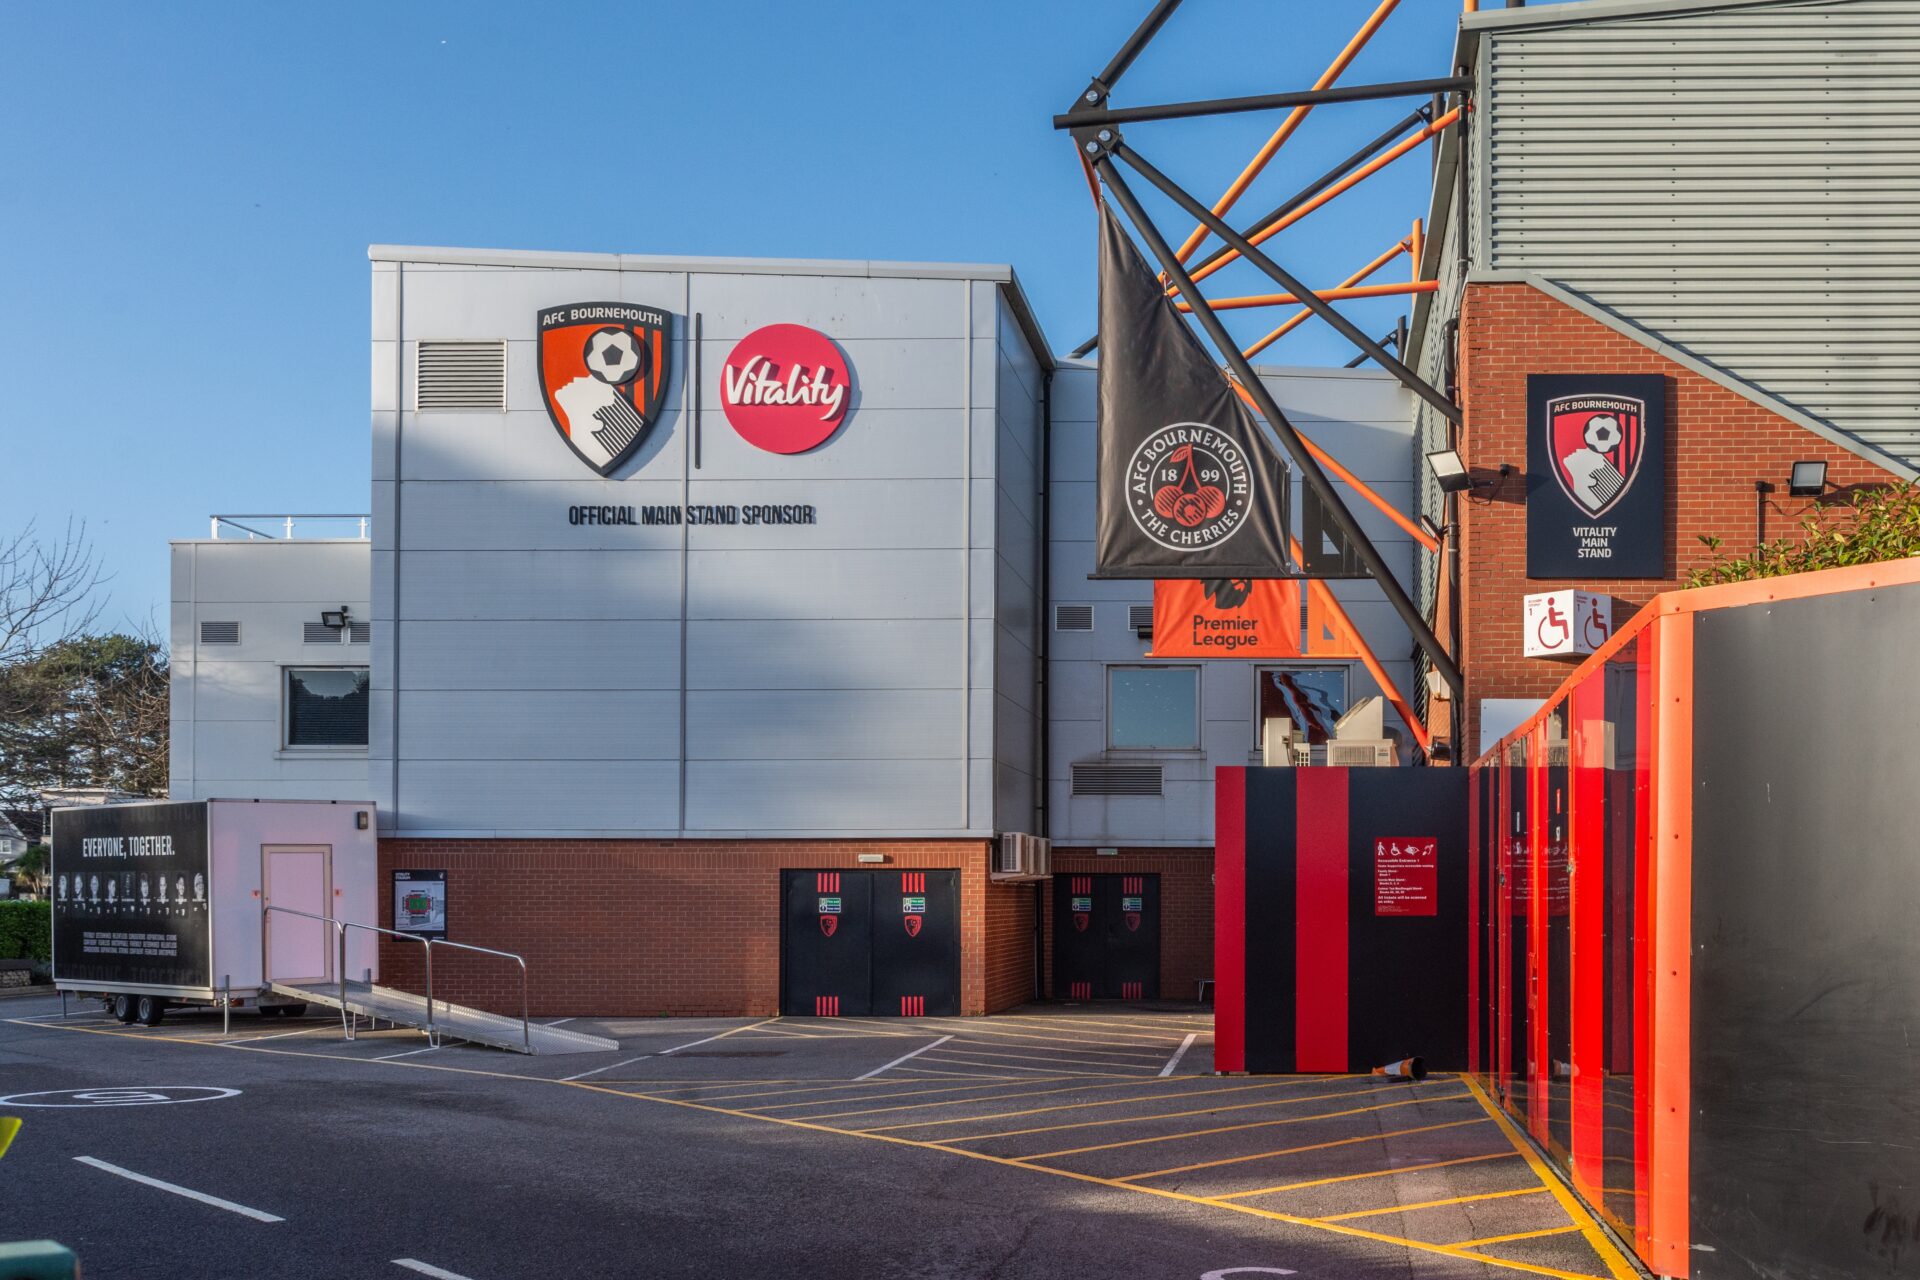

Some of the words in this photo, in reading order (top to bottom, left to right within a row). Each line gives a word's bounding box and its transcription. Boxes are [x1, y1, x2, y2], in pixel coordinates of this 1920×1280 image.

[542, 311, 565, 326] AFC
[570, 307, 663, 326] BOURNEMOUTH
[726, 355, 844, 421] Vitality
[1554, 402, 1571, 413] AFC
[1572, 401, 1638, 413] BOURNEMOUTH
[1133, 460, 1151, 494] AFC
[1143, 428, 1248, 495] BOURNEMOUTH
[1161, 469, 1177, 482] 18
[1200, 469, 1220, 482] 99
[568, 506, 634, 525] OFFICIAL
[641, 506, 682, 525] MAIN
[686, 506, 736, 525] STAND
[742, 505, 813, 524] SPONSOR
[1140, 509, 1167, 538] THE
[1170, 509, 1240, 545] CHERRIES
[1572, 527, 1617, 537] VITALITY
[1582, 537, 1608, 548] MAIN
[1578, 548, 1612, 559] STAND
[1193, 615, 1258, 630] Premier
[1193, 631, 1258, 650] League
[82, 837, 127, 860] EVERYONE,
[129, 835, 176, 857] TOGETHER.
